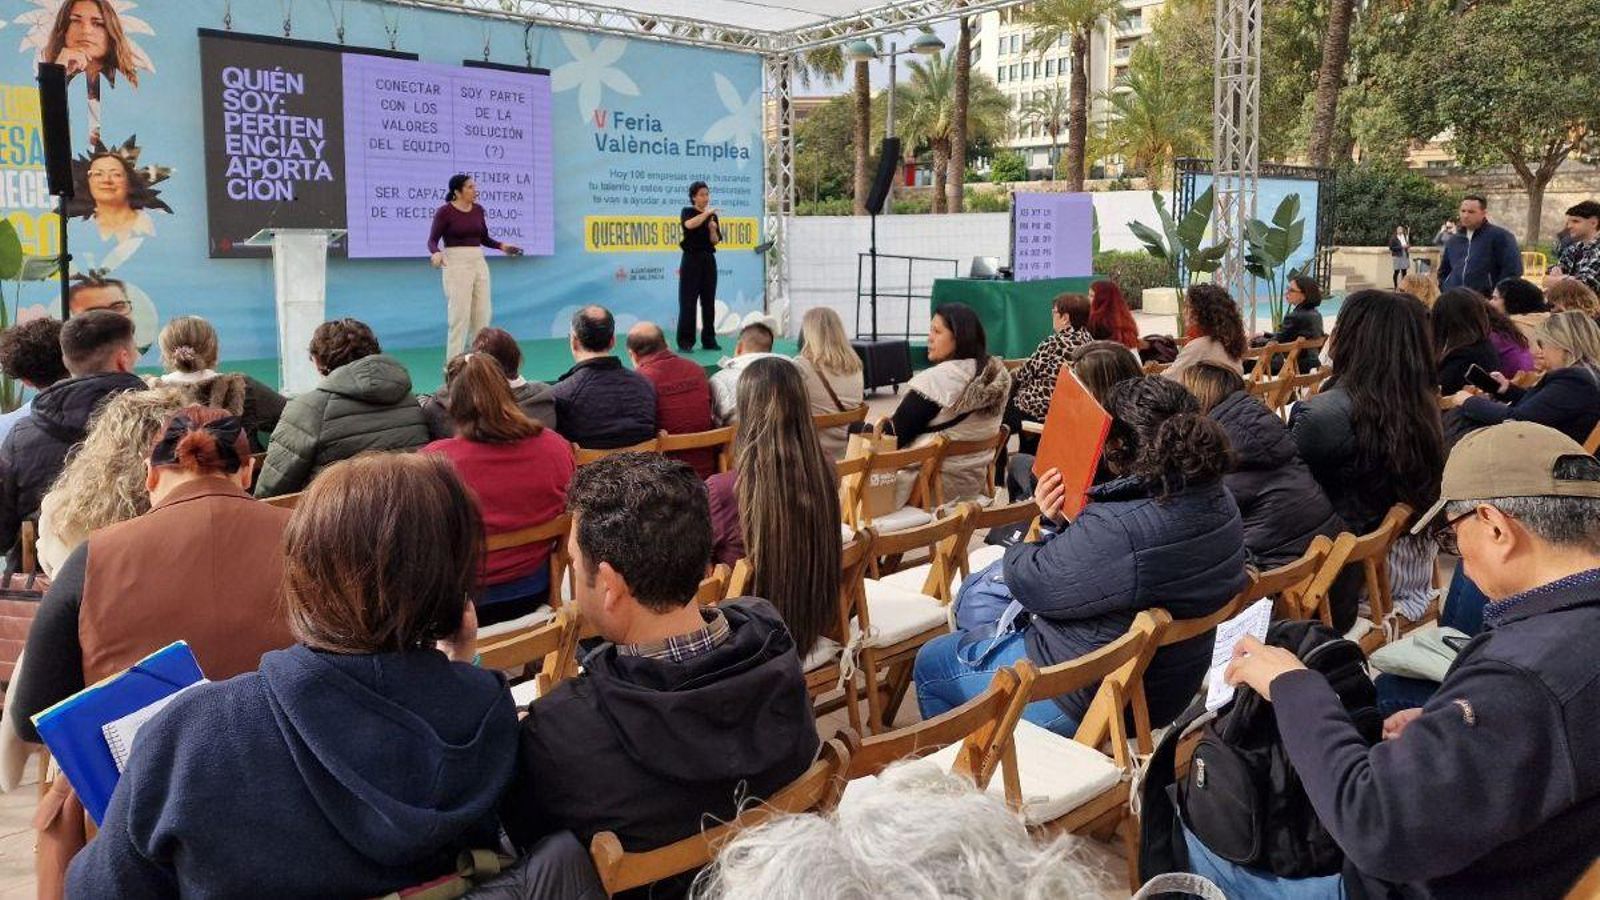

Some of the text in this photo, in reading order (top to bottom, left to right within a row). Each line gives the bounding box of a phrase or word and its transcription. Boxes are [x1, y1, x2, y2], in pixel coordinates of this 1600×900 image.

[222, 65, 305, 95] QUIÉN
[376, 79, 441, 95] CONECTAR
[223, 89, 286, 114] SOY:
[460, 86, 525, 104] SOY PARTE
[381, 99, 438, 115] CON LOS
[475, 107, 512, 120] DE LA
[224, 111, 323, 139] PERTEN
[381, 120, 438, 134] VALORES
[594, 109, 662, 132] V Feria
[464, 124, 523, 140] SOLUCIÓN
[225, 134, 326, 160] ENCIA Y
[369, 138, 450, 154] DEL EQUIPO
[484, 145, 505, 160] (?)
[595, 133, 750, 161] València Emplea
[226, 156, 333, 182] APORTA
[609, 169, 627, 180] Hoy
[516, 172, 531, 184] LA
[375, 186, 447, 200] SER CAPAZ
[474, 191, 524, 201] RONTERA
[632, 184, 638, 193] y
[371, 206, 435, 219] DE RECIB
[489, 227, 523, 237] SONAL
[592, 222, 751, 247] QUEREMOS CRE NTIGO
